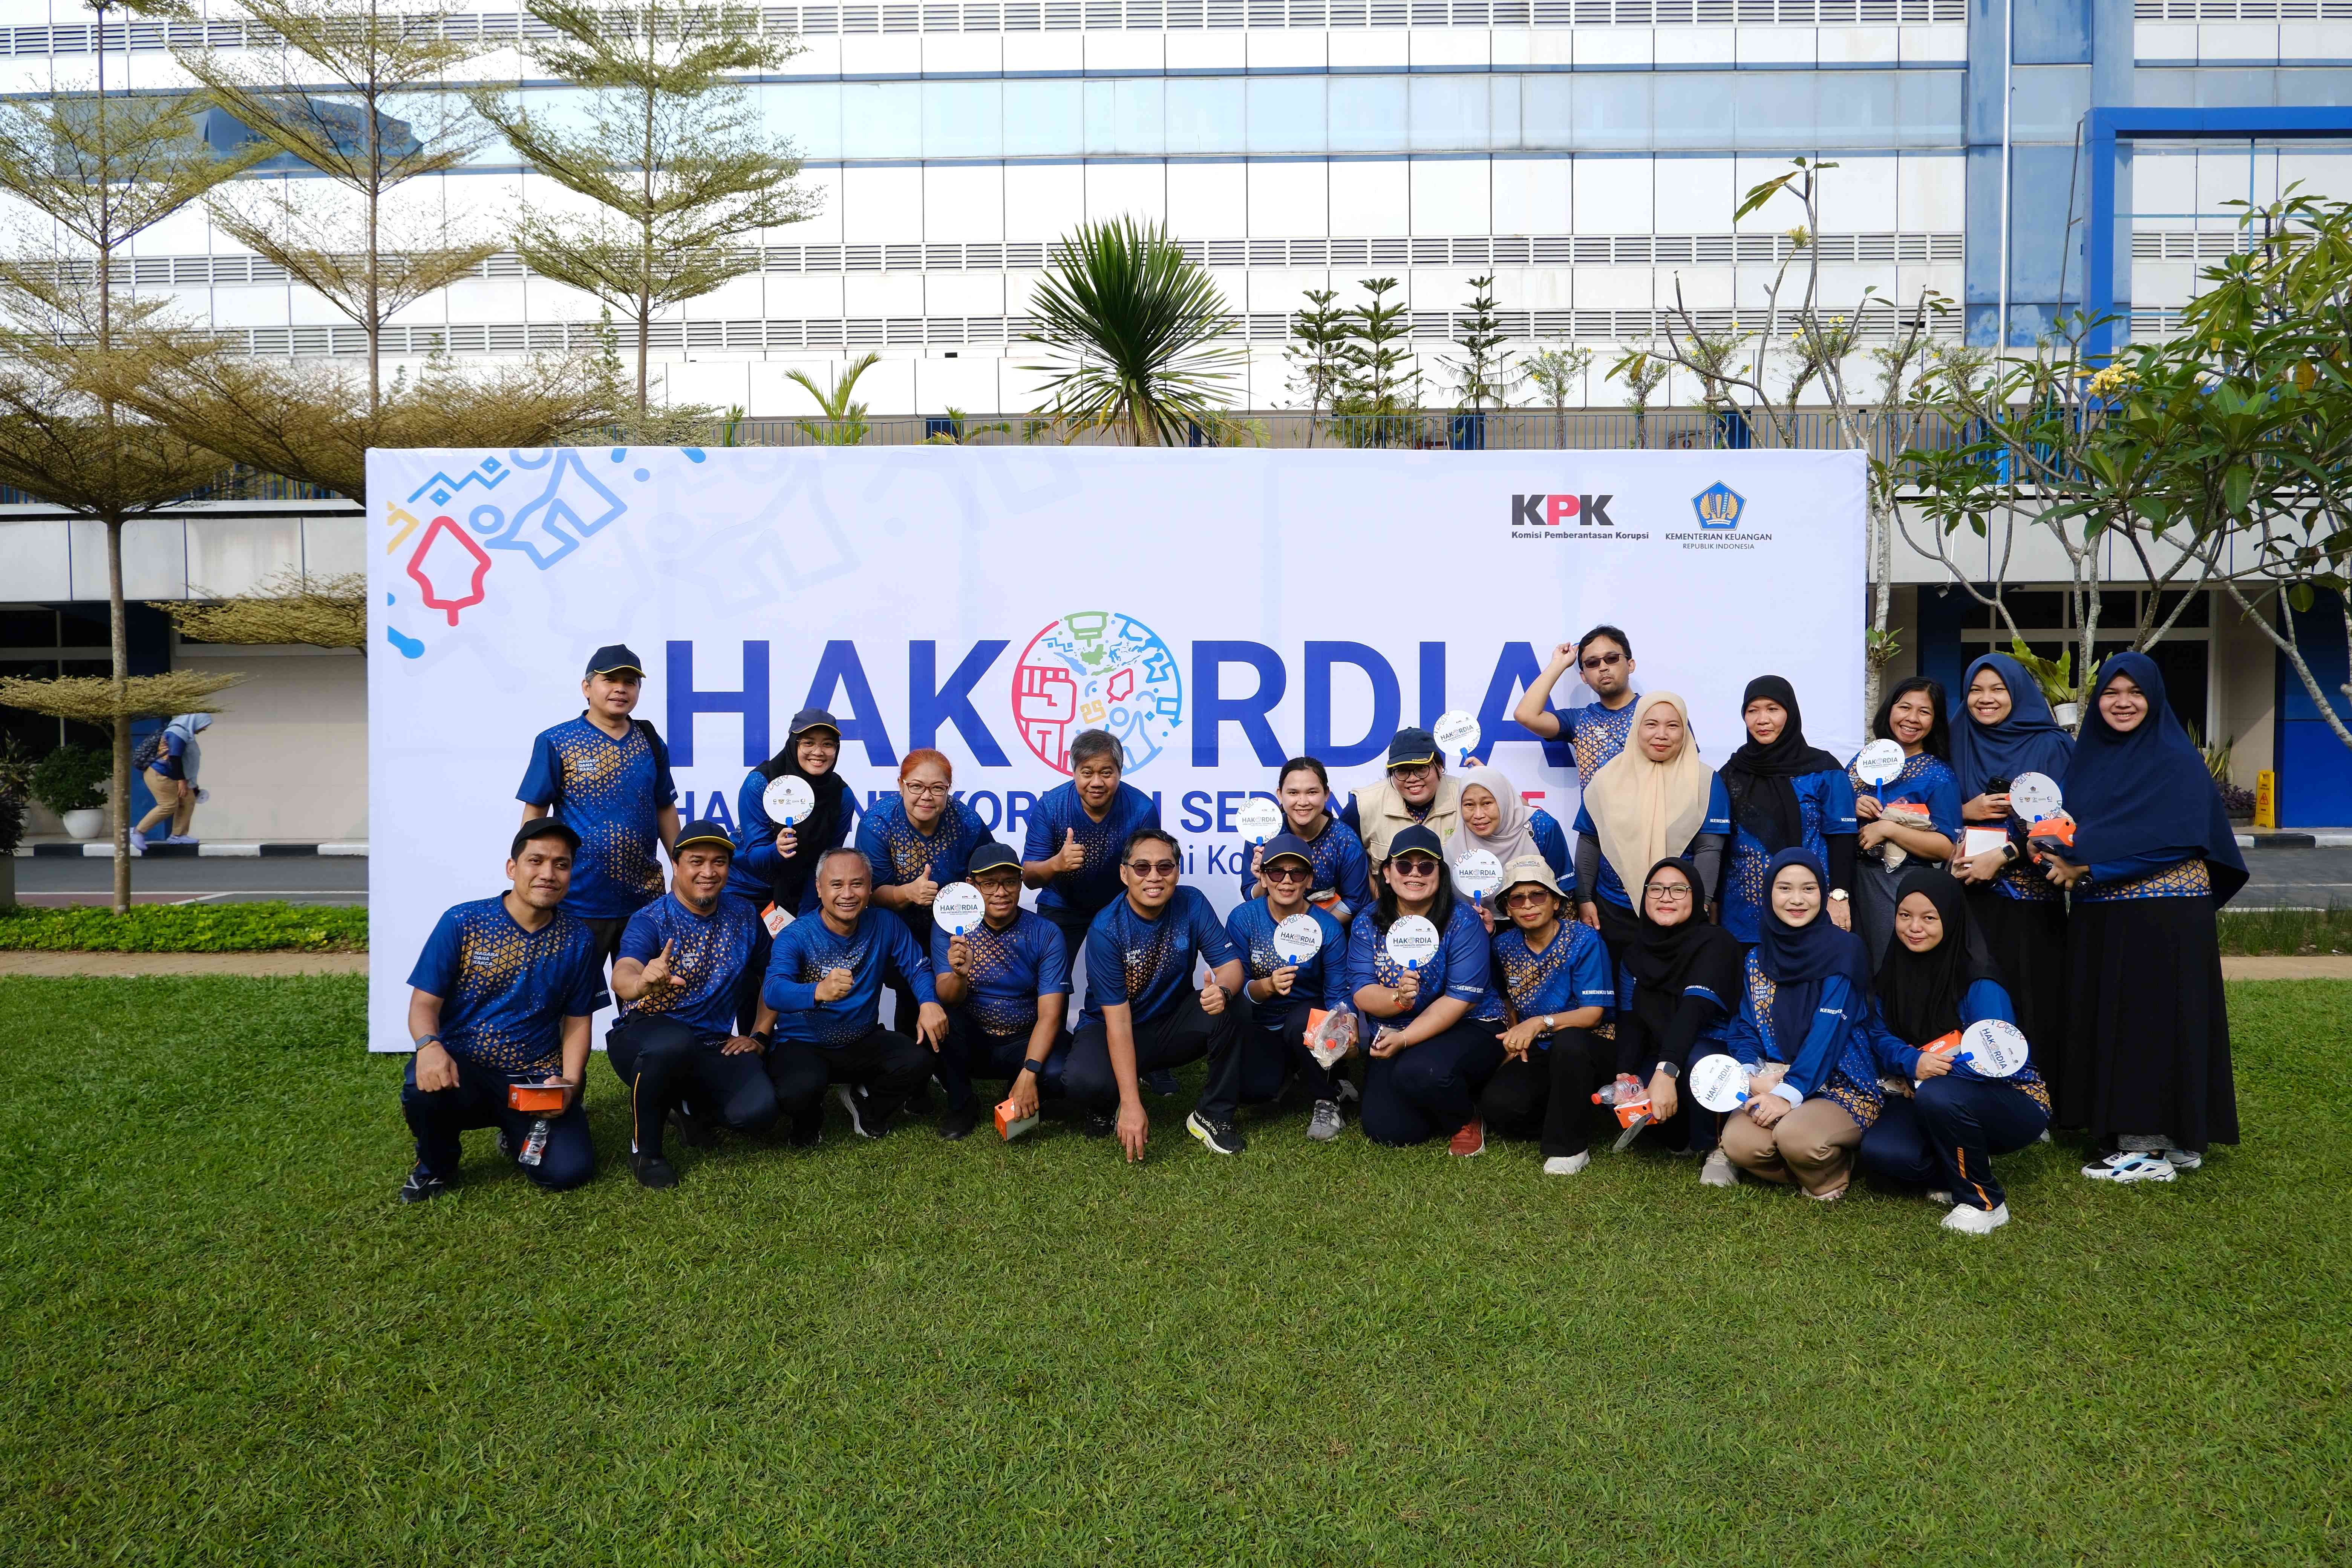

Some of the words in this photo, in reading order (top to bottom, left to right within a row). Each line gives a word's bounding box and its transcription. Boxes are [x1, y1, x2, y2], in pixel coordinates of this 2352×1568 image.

[1512, 494, 1614, 525] KPK
[1616, 531, 1648, 540] Korupsi
[1281, 931, 1315, 944] HAKORDIA
